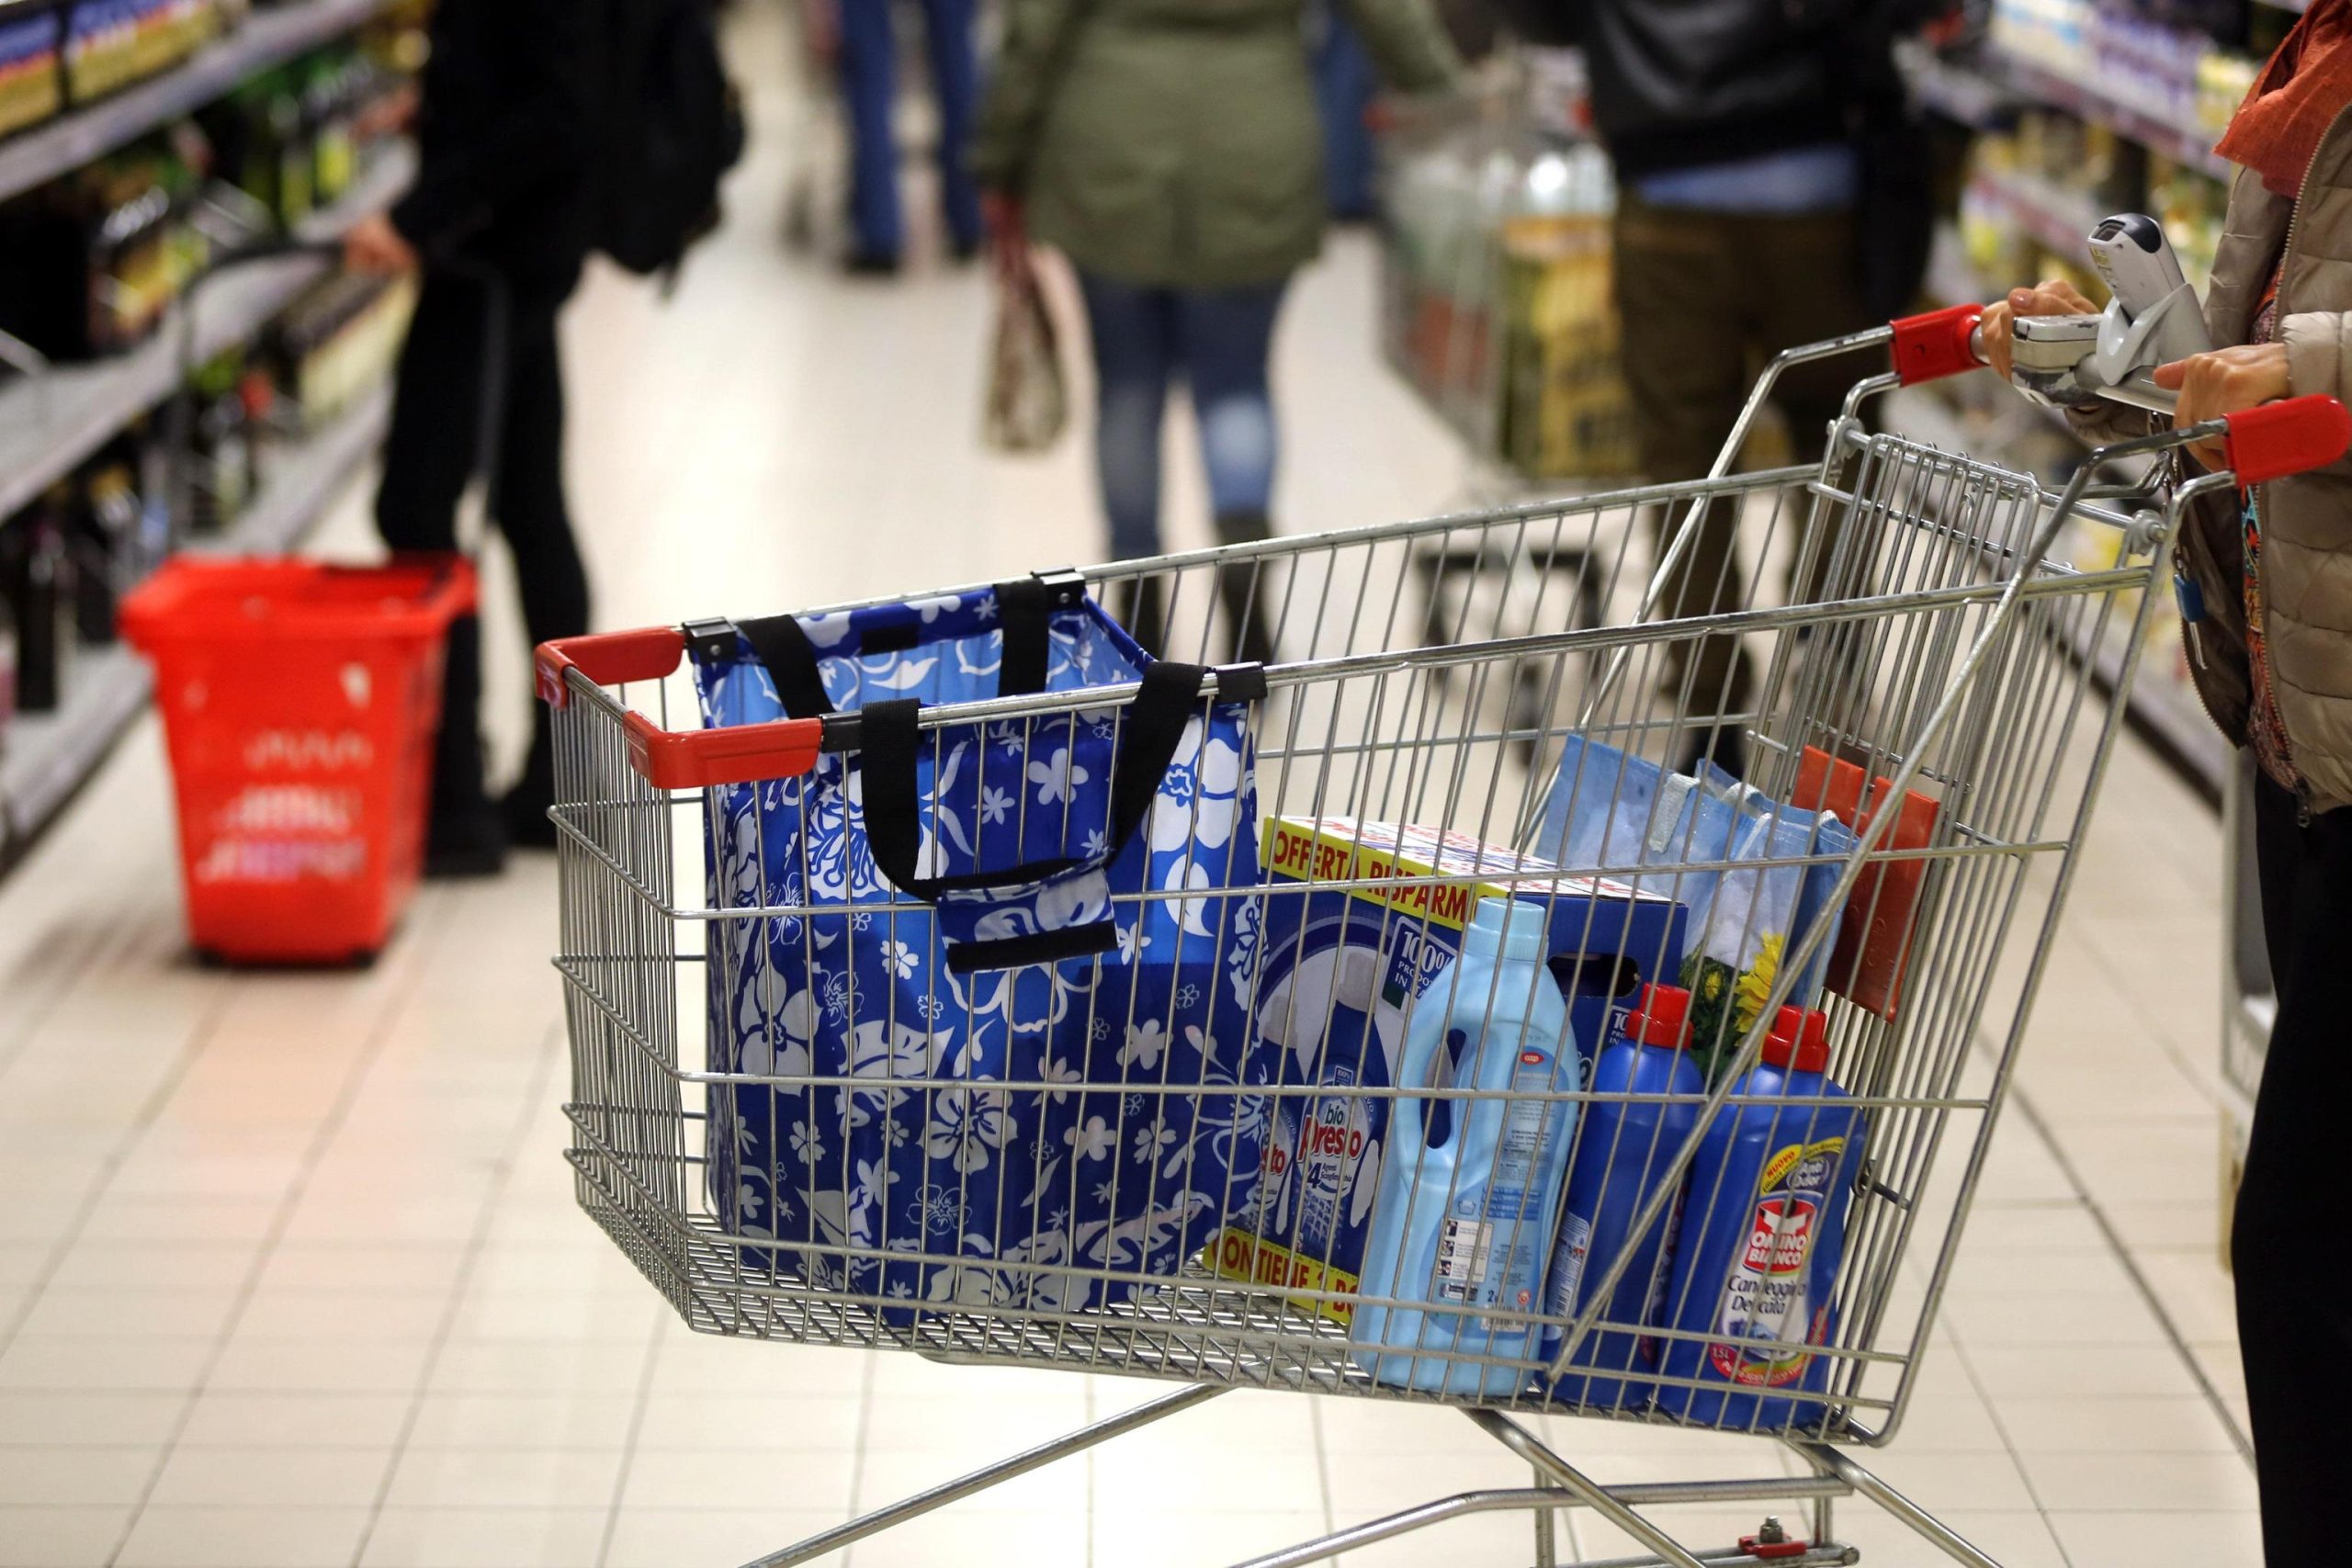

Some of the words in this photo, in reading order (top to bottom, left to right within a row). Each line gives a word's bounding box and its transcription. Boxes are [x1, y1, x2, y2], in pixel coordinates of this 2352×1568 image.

[1273, 829, 1362, 882] OFFERTA
[1367, 861, 1488, 924] RISPARM
[1394, 972, 1408, 988] IN
[1397, 961, 1434, 987] PRODO
[1613, 1012, 1629, 1032] 10
[1325, 1103, 1344, 1125] bio
[1307, 1162, 1322, 1189] 4
[1751, 1231, 1808, 1251] OMINO
[1728, 1275, 1807, 1302] Caneggia
[1732, 1295, 1786, 1315] Decata
